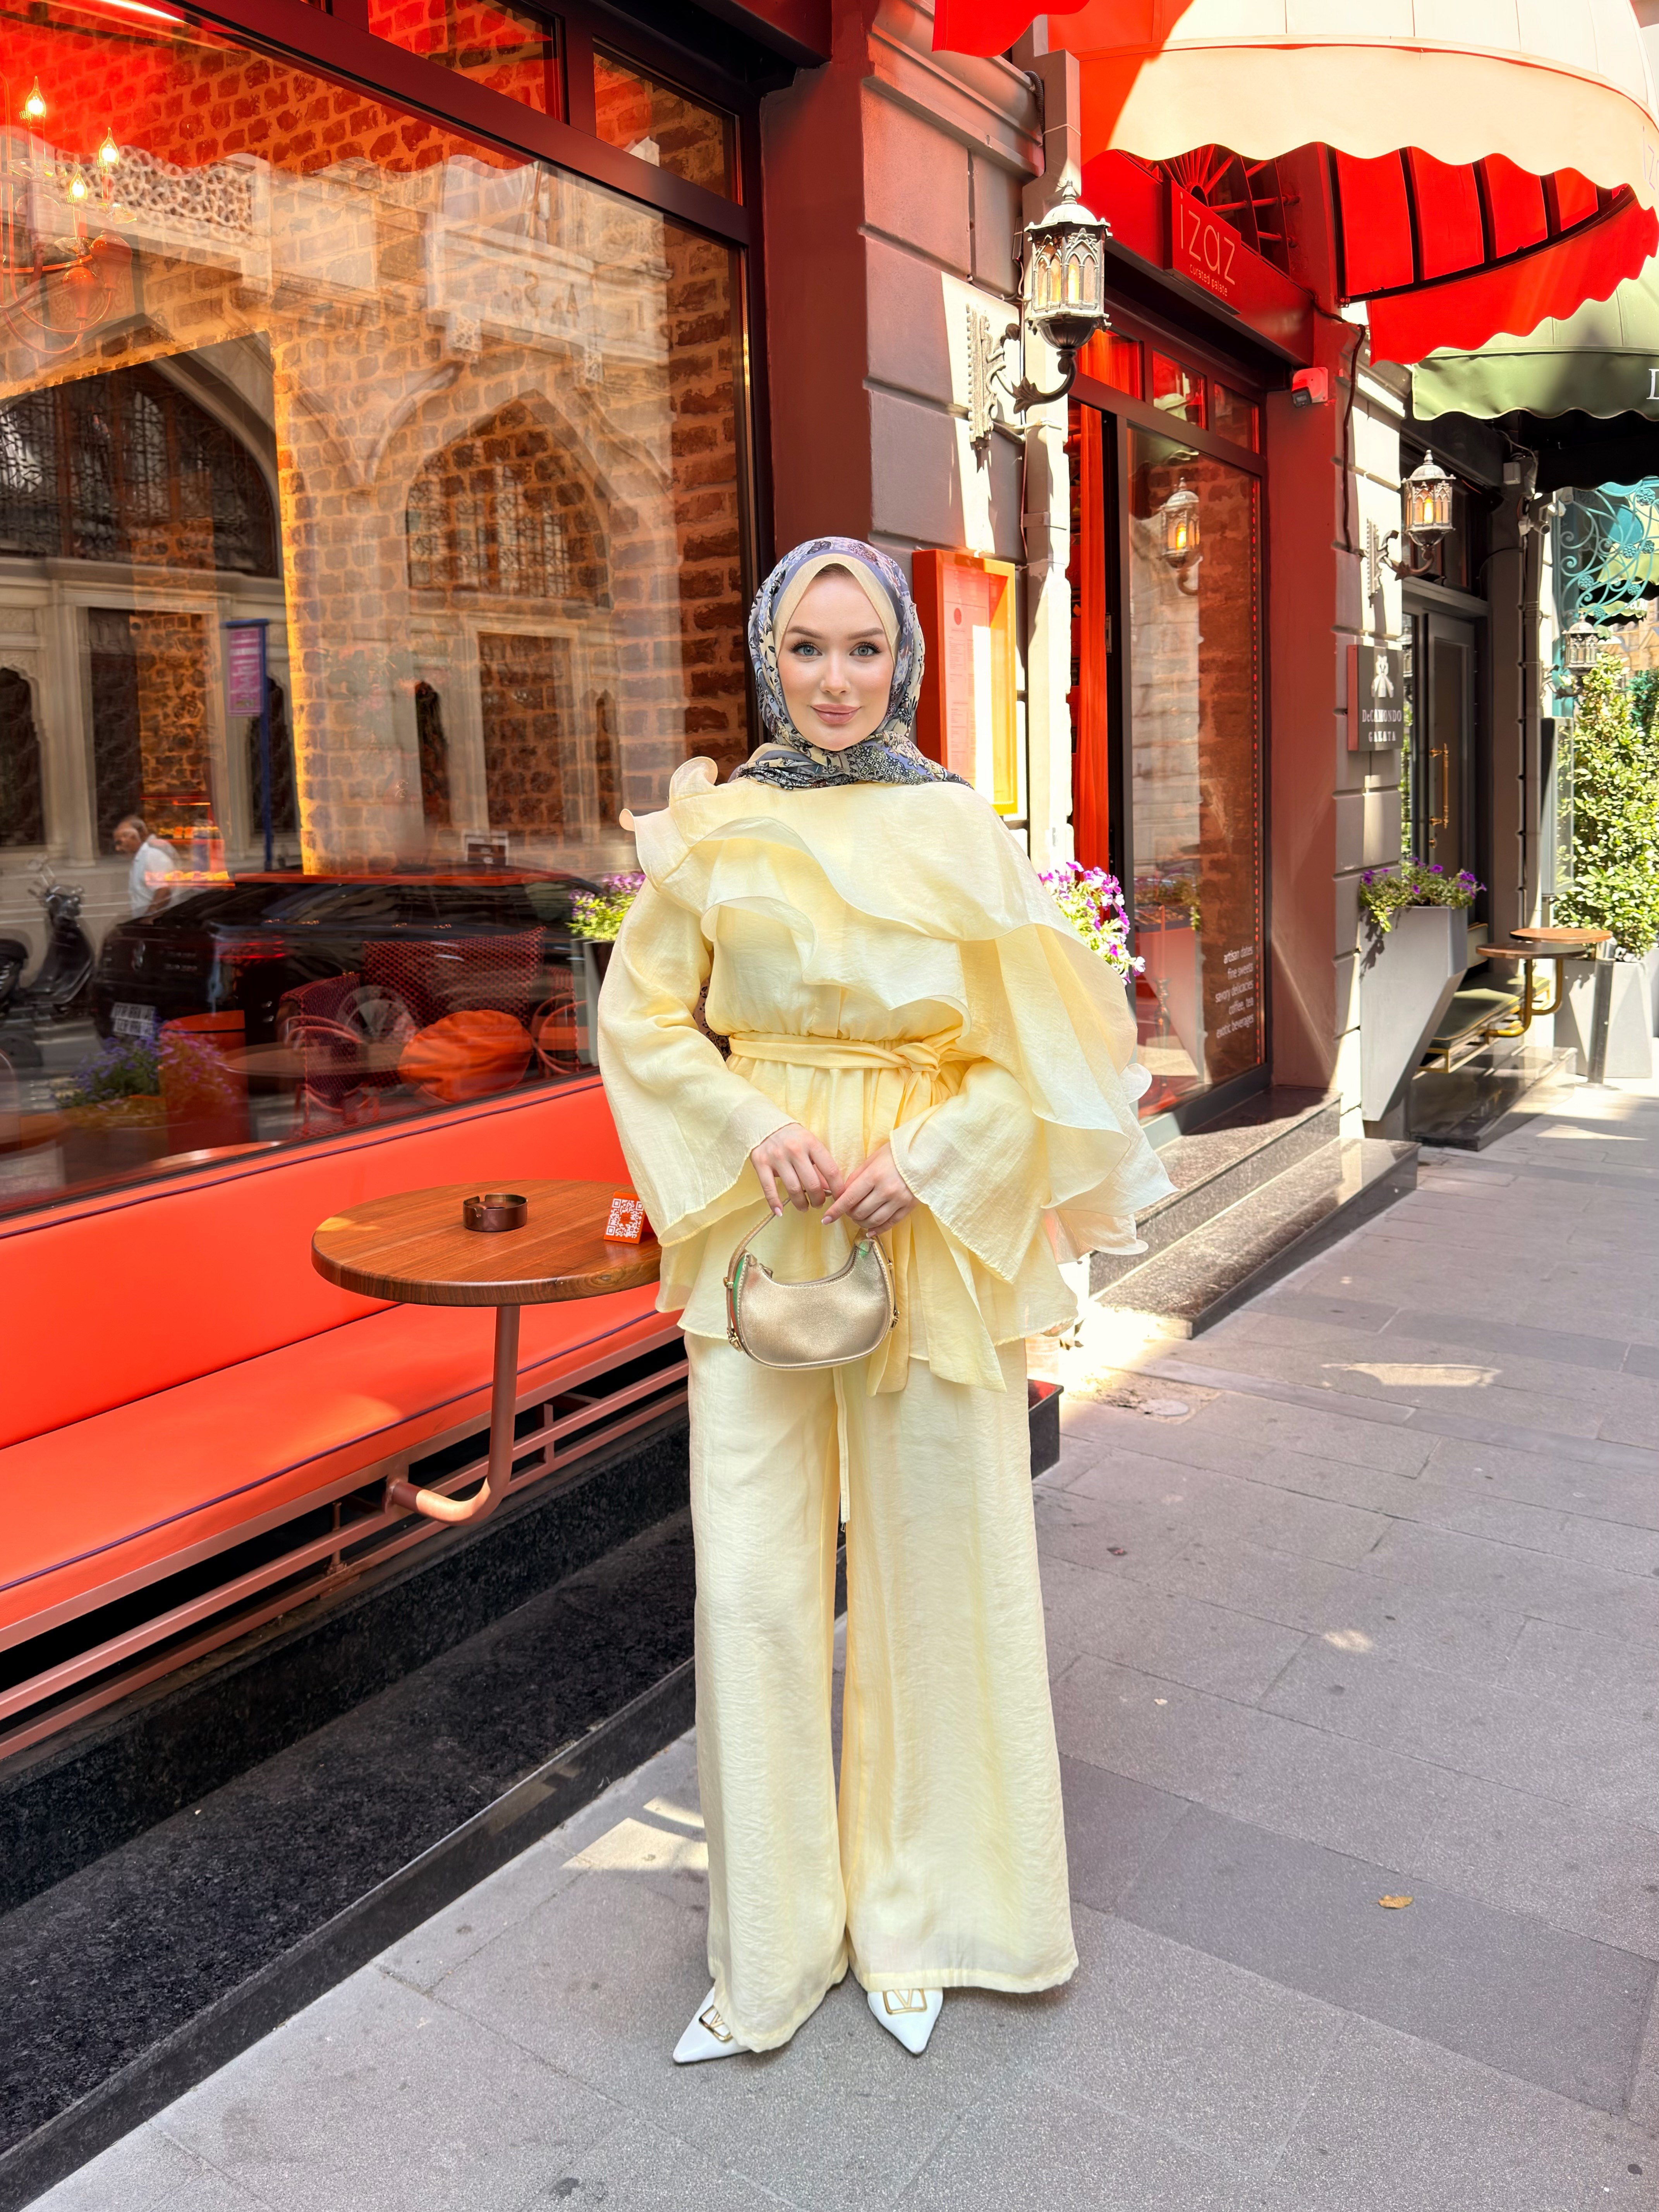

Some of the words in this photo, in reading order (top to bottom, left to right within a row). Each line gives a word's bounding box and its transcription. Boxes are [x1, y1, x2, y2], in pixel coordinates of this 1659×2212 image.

[1180, 191, 1235, 285] izaz
[1190, 263, 1210, 285] curated
[1211, 278, 1228, 297] palate
[1362, 709, 1401, 722] DeCAMONDO
[1368, 731, 1396, 742] GALATA
[1240, 946, 1253, 958] dates
[1227, 968, 1237, 980] fine
[1238, 962, 1253, 976] sweets
[1215, 988, 1230, 1003] savory
